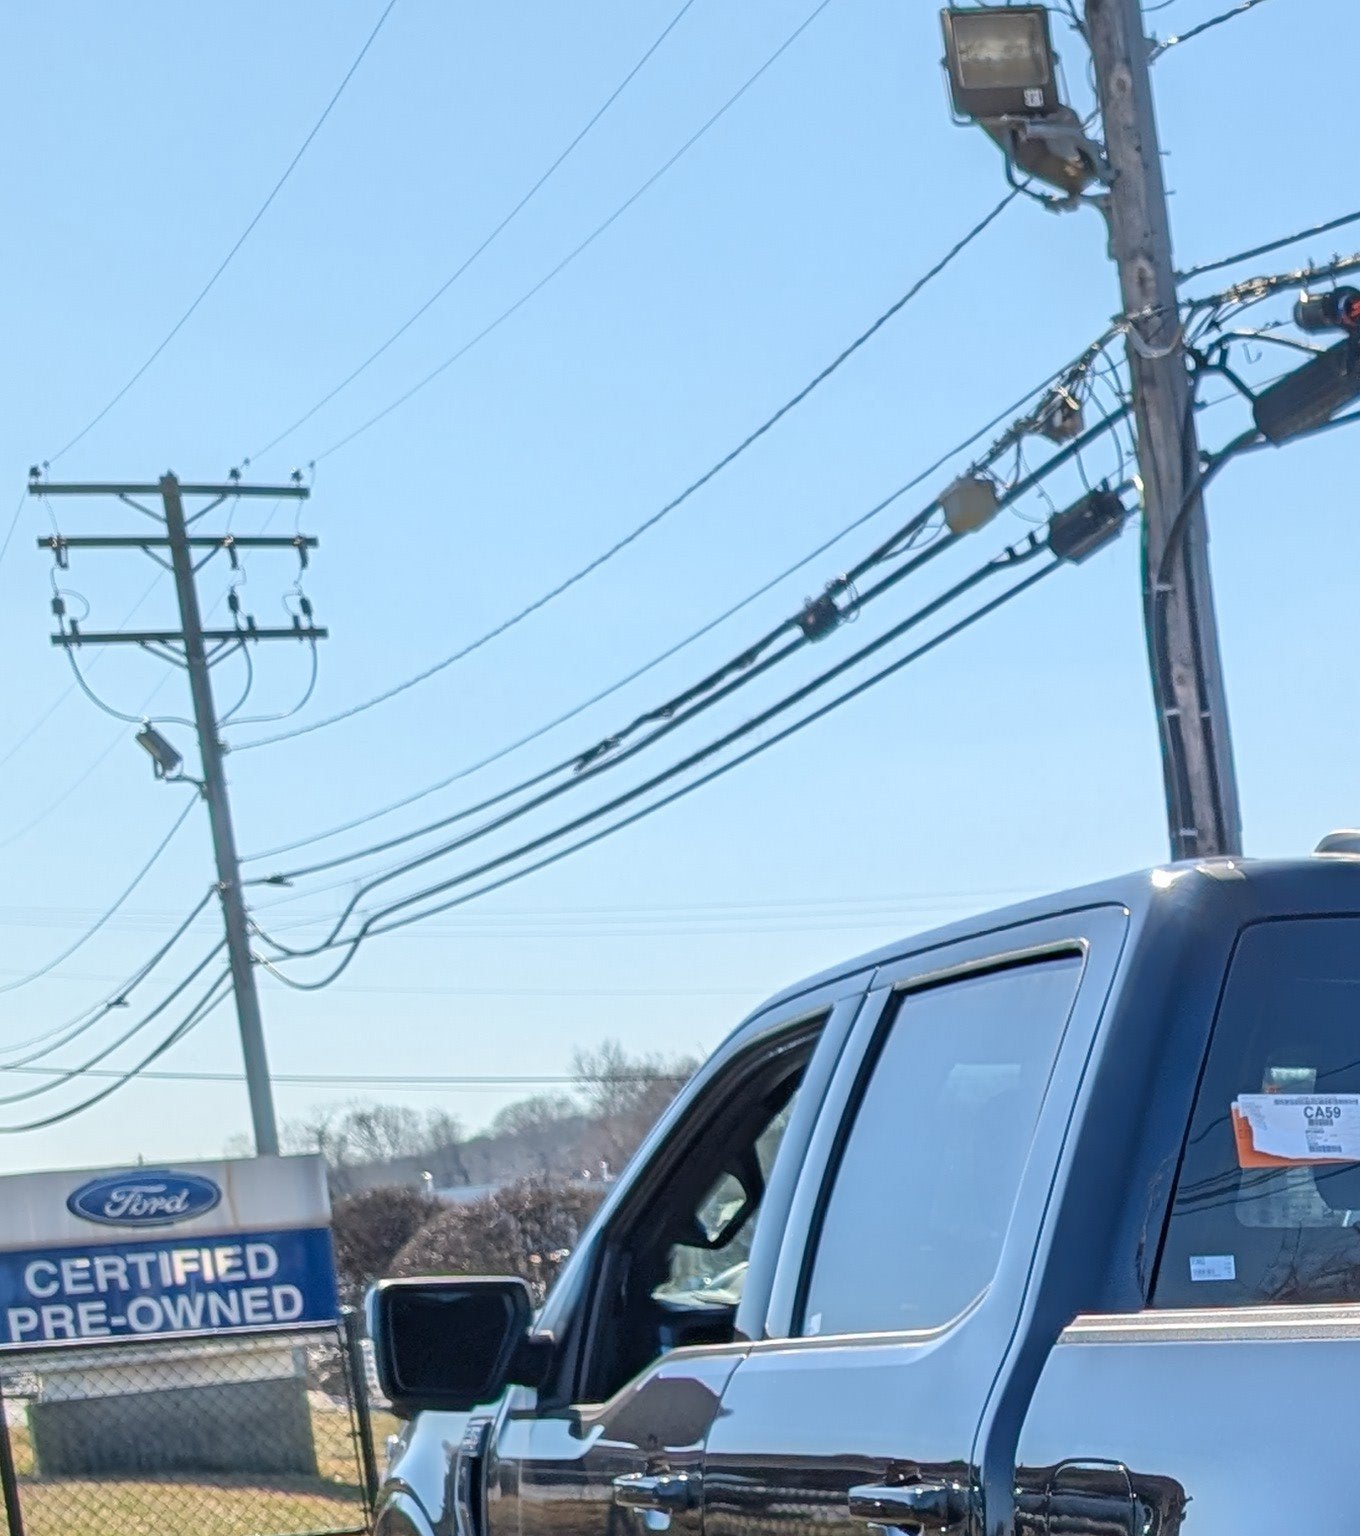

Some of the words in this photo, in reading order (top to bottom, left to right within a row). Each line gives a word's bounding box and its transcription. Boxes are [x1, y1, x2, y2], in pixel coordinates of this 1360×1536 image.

[1303, 1105, 1342, 1119] CA59
[103, 1183, 190, 1218] Ford
[24, 1243, 279, 1298] CERTIFIED
[7, 1284, 304, 1343] PRE-OWNED
